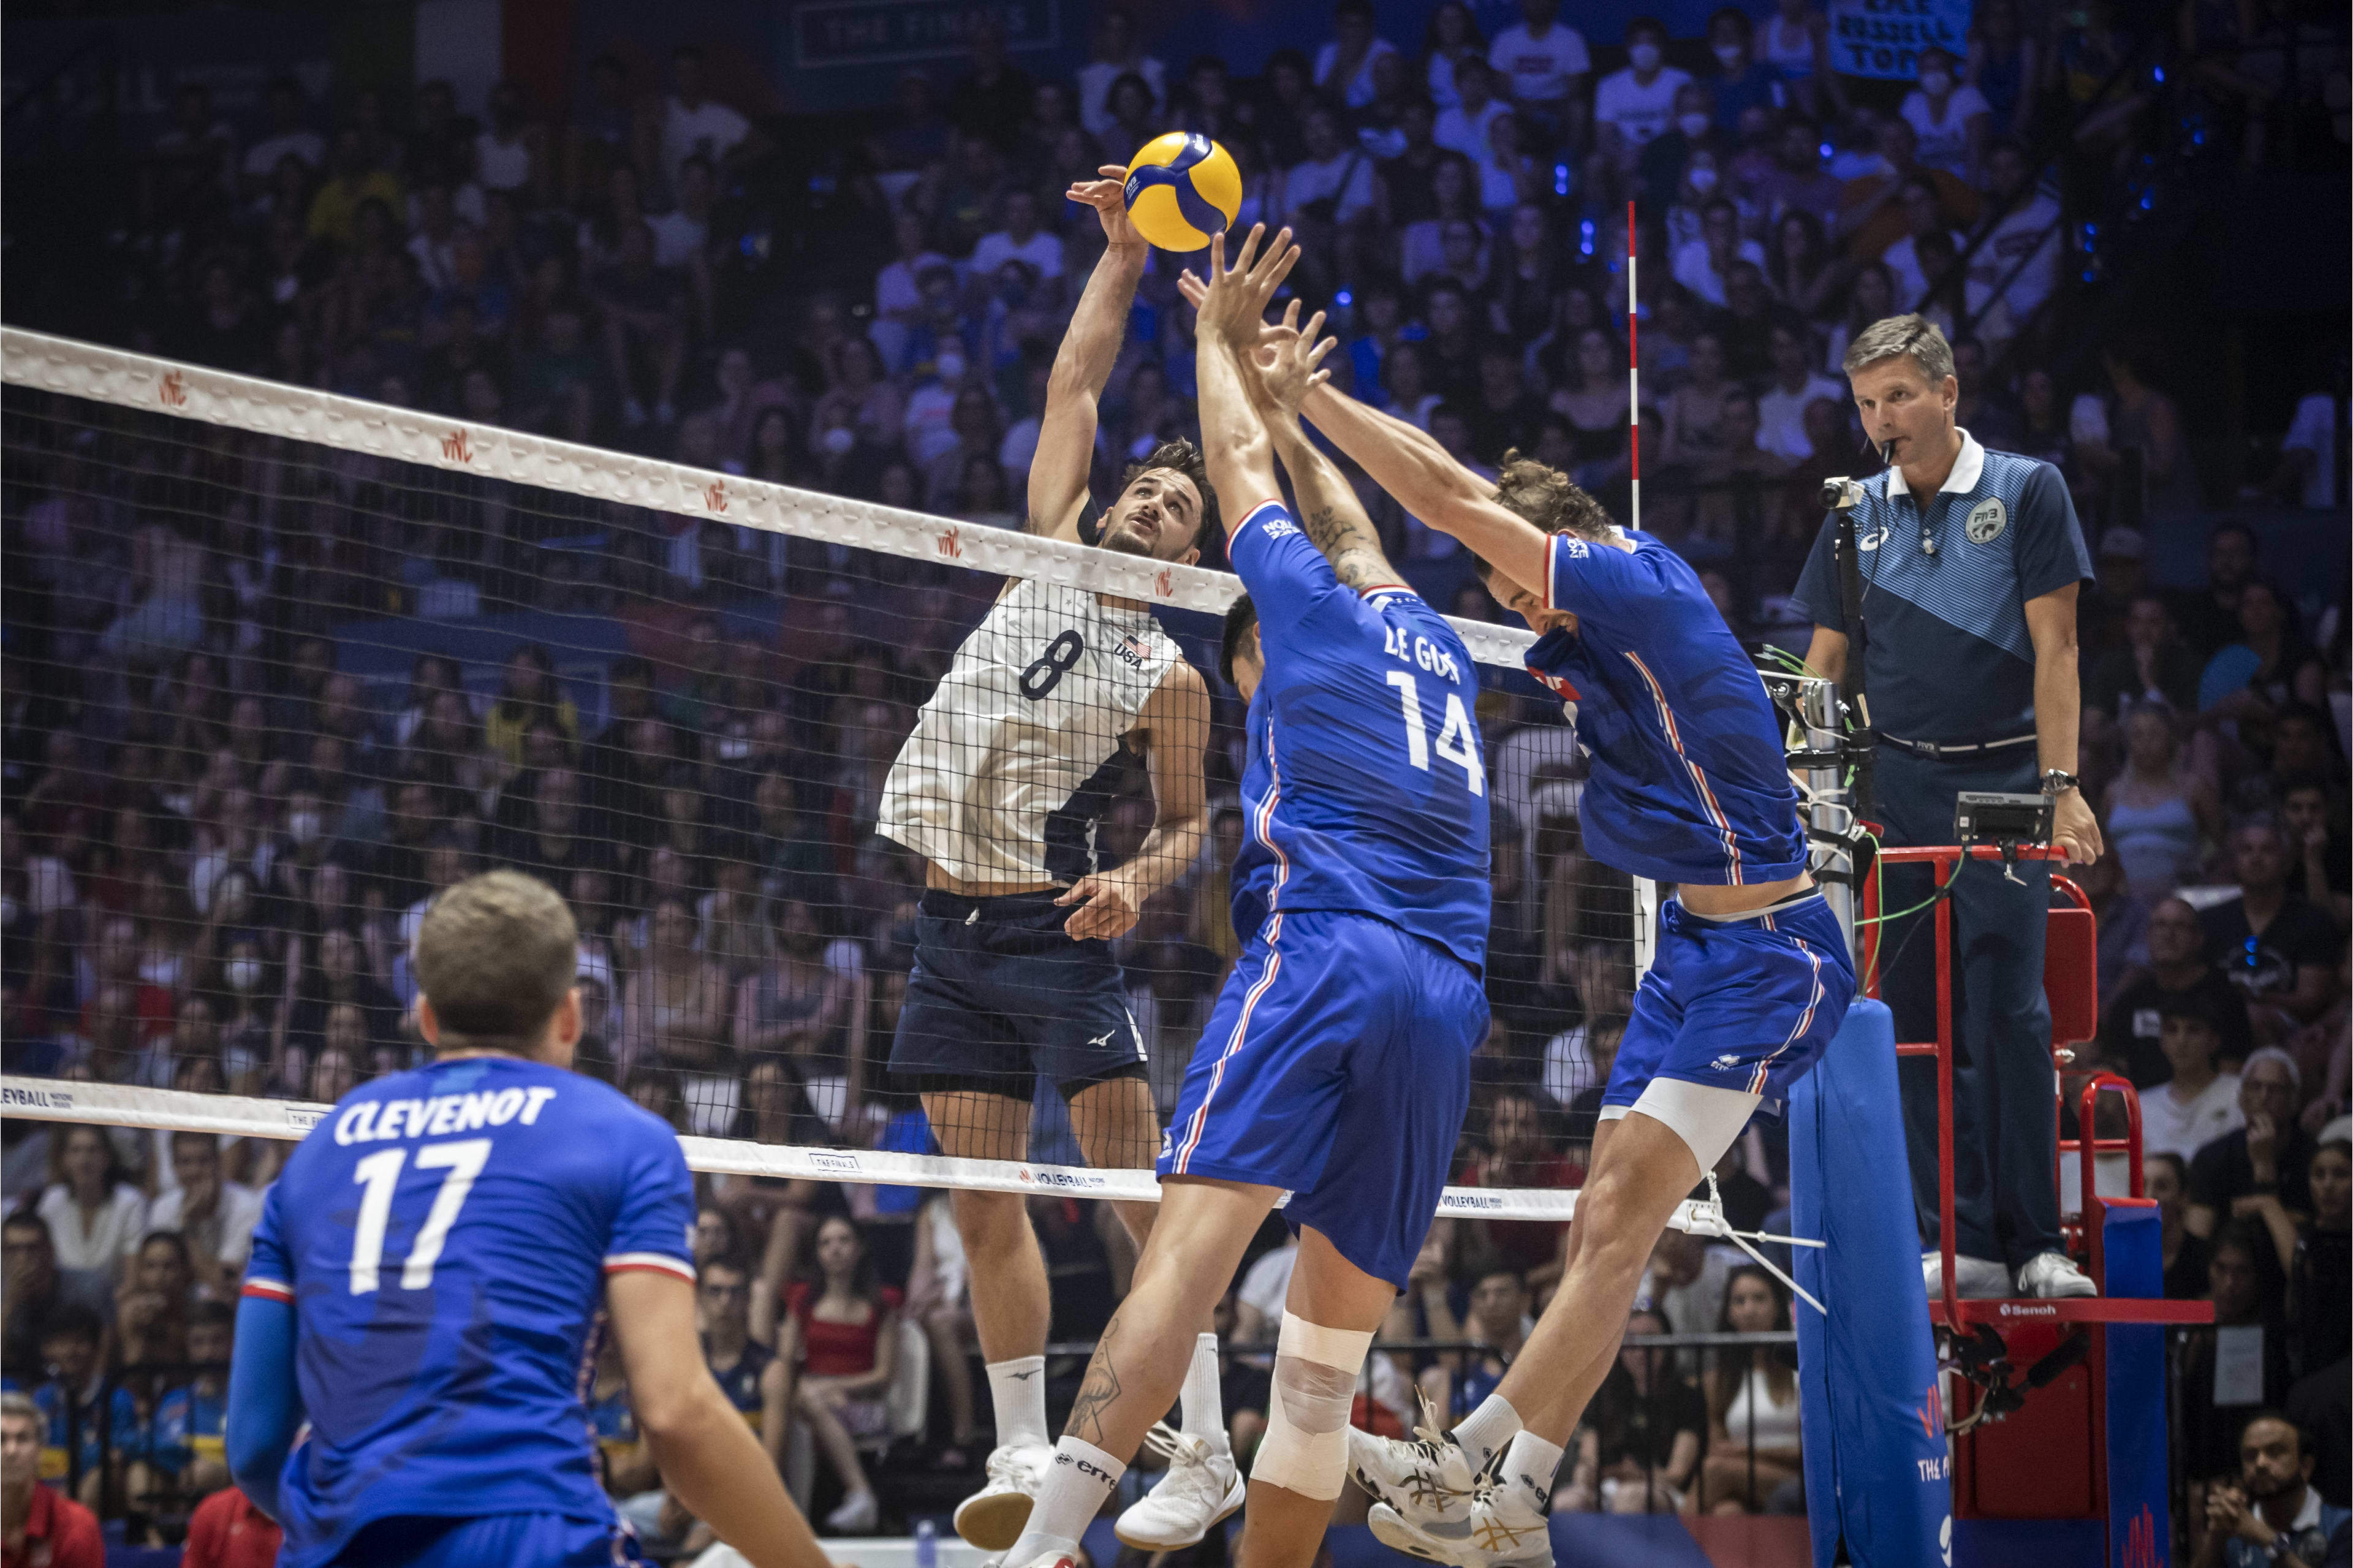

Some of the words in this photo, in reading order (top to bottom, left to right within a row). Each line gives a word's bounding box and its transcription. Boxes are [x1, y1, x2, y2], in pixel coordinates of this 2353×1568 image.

[1114, 643, 1143, 670] USA
[1384, 626, 1410, 662] LE
[1019, 629, 1083, 701] 8
[1387, 671, 1483, 797] 14
[1, 1088, 49, 1107] EYBALL
[335, 1086, 556, 1146] CLEVENOT
[1034, 1172, 1093, 1187] VOLLEYBALL
[1442, 1195, 1490, 1209] VOLLEYBALL
[349, 1139, 493, 1297] 17
[2012, 1304, 2056, 1316] Senoh
[1917, 1456, 1941, 1482] THE
